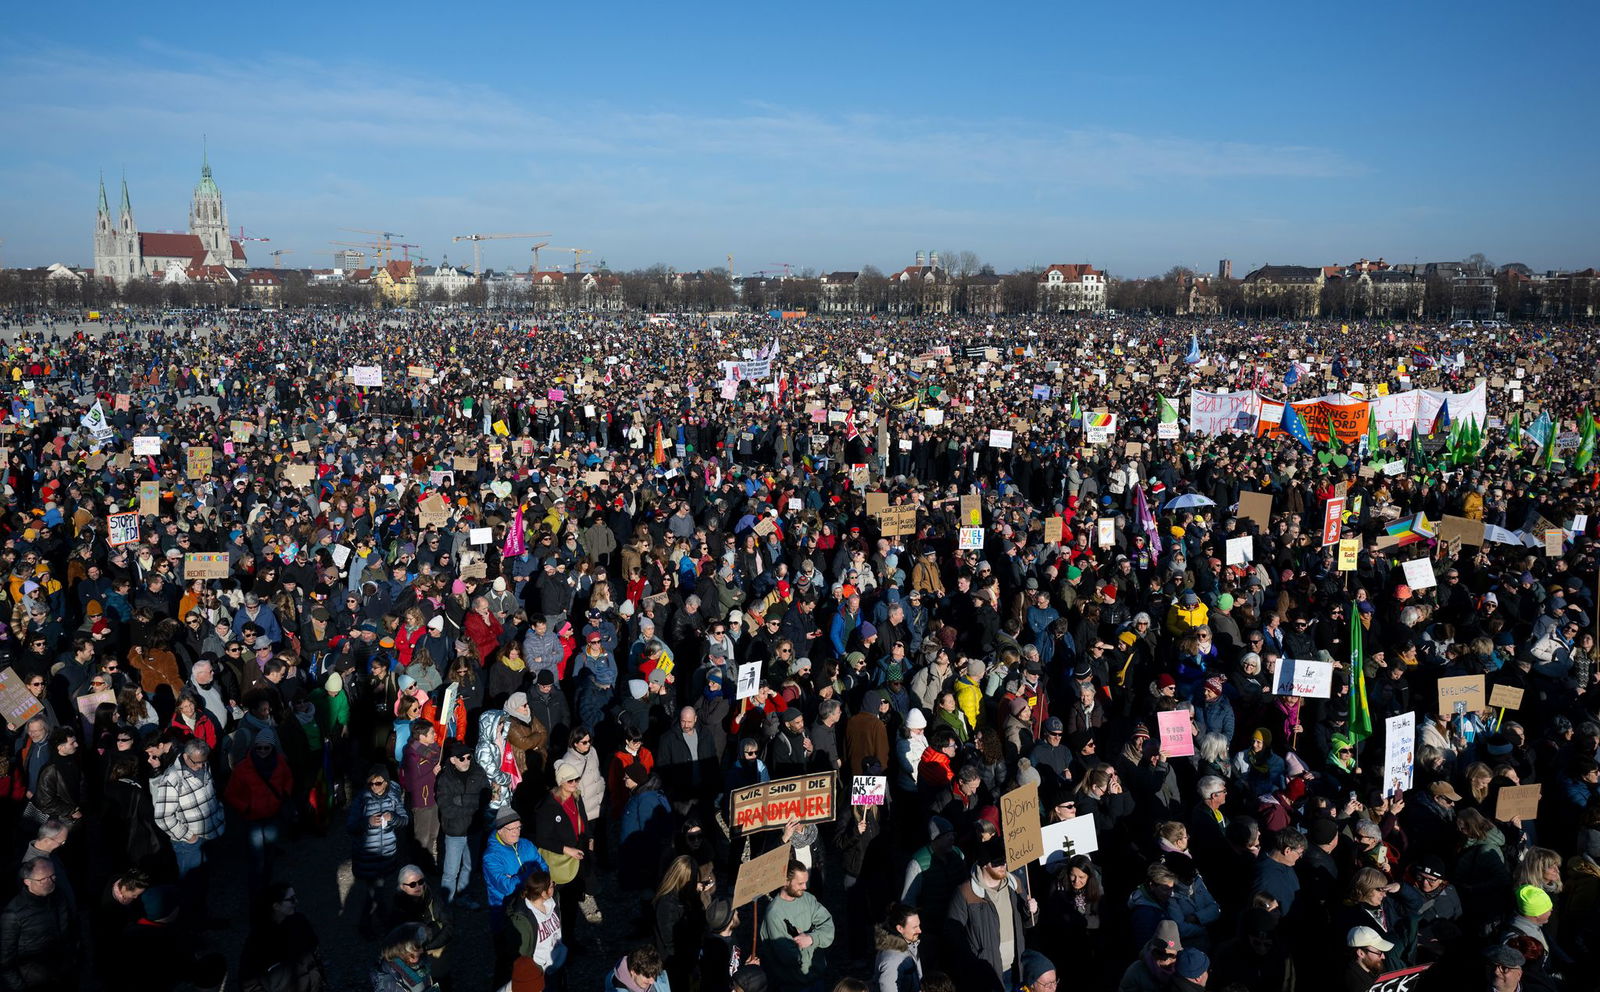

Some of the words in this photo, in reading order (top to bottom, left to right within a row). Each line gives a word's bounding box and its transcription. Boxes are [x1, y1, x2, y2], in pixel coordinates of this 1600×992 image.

[1353, 409, 1366, 419] IST
[110, 514, 137, 529] STOPPT
[961, 529, 982, 538] VIEL
[961, 537, 982, 545] FALT
[186, 569, 207, 578] RECHTE
[853, 776, 876, 786] ALICE
[740, 789, 761, 800] WIR
[769, 783, 797, 794] SIND
[808, 778, 826, 789] DIE
[736, 794, 831, 828] BRANDMAUER!
